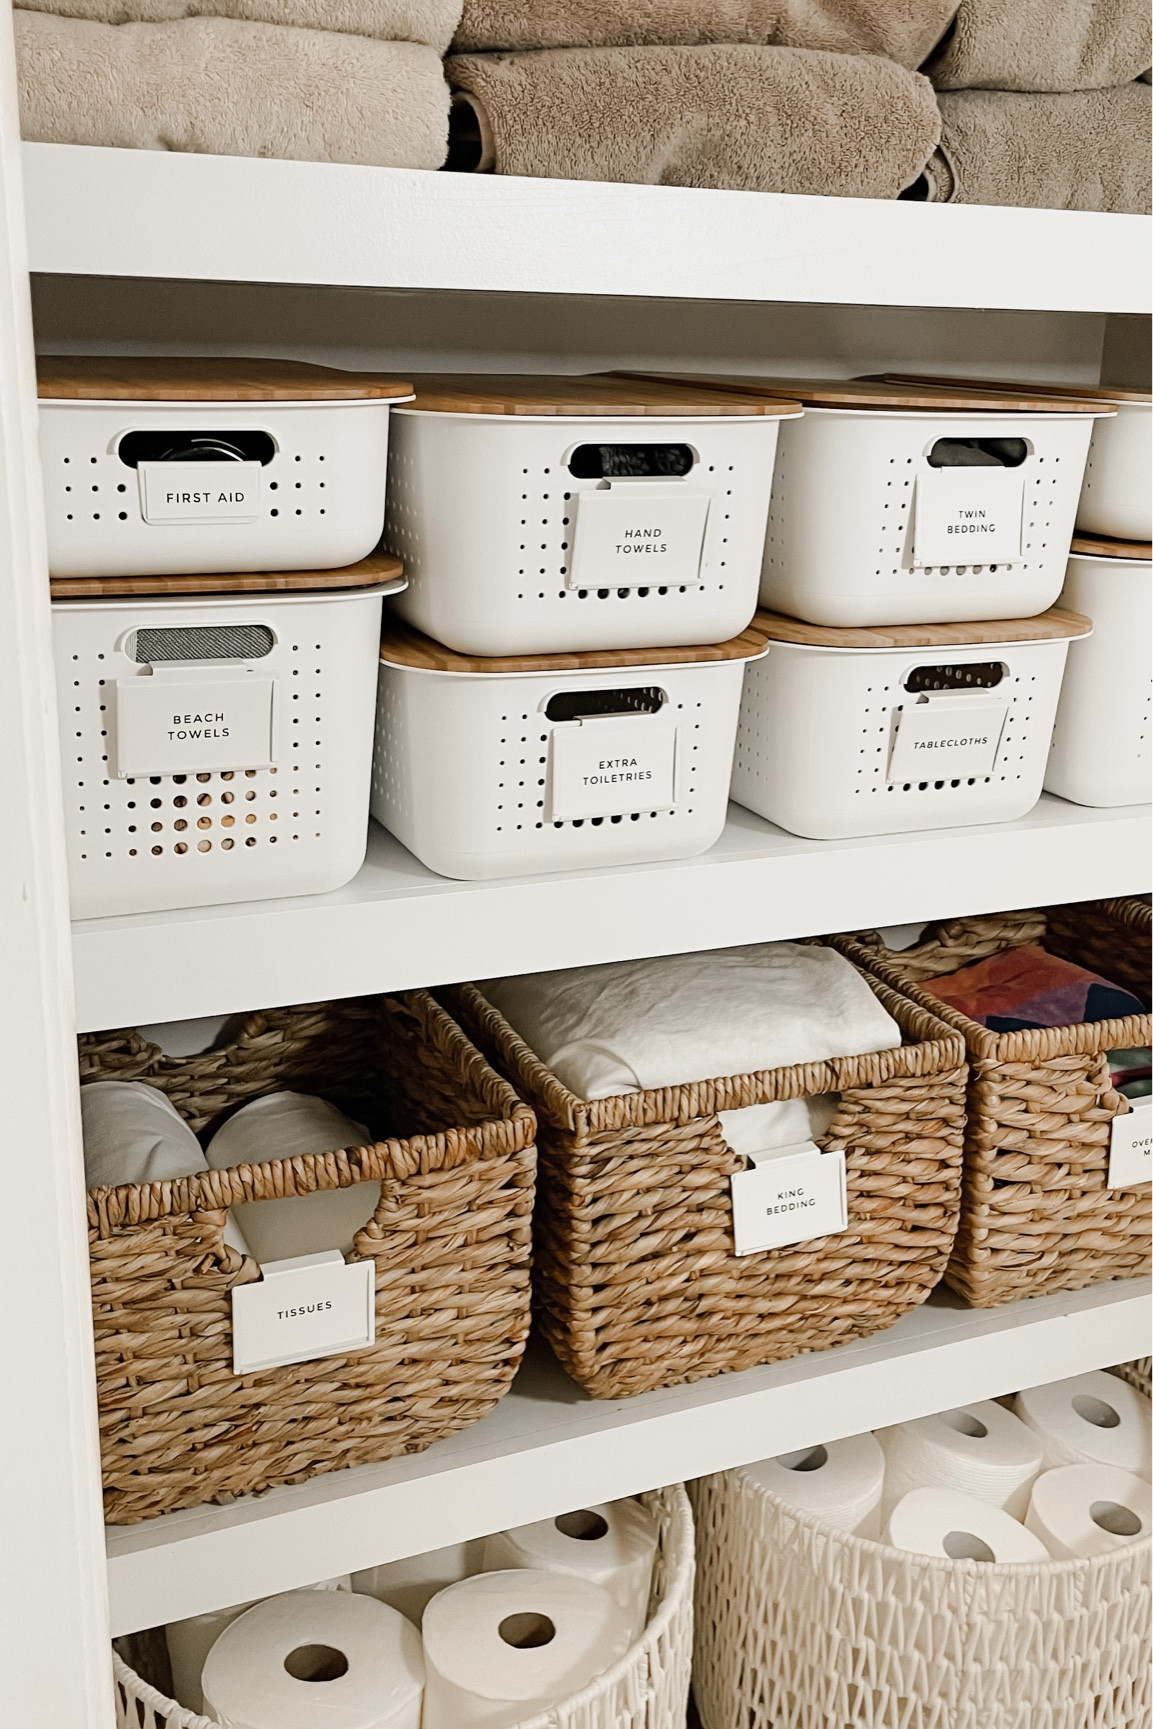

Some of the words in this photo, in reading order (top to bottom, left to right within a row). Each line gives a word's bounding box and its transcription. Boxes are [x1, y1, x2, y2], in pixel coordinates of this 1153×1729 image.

[166, 492, 211, 504] FIRST
[217, 492, 245, 503] AID
[958, 510, 986, 519] TWIN
[624, 528, 662, 539] HAND
[947, 523, 996, 534] BEDDING
[615, 543, 667, 554] TOWELS
[173, 712, 224, 725] BEACH
[167, 727, 231, 741] TOWELS
[913, 736, 989, 750] TABLECLOTHS
[598, 758, 638, 770] EXTRA
[582, 770, 653, 786] TOILETRIES
[777, 1187, 805, 1201] KING
[766, 1198, 816, 1216] BEDDING
[276, 1300, 333, 1320] TISSUES
